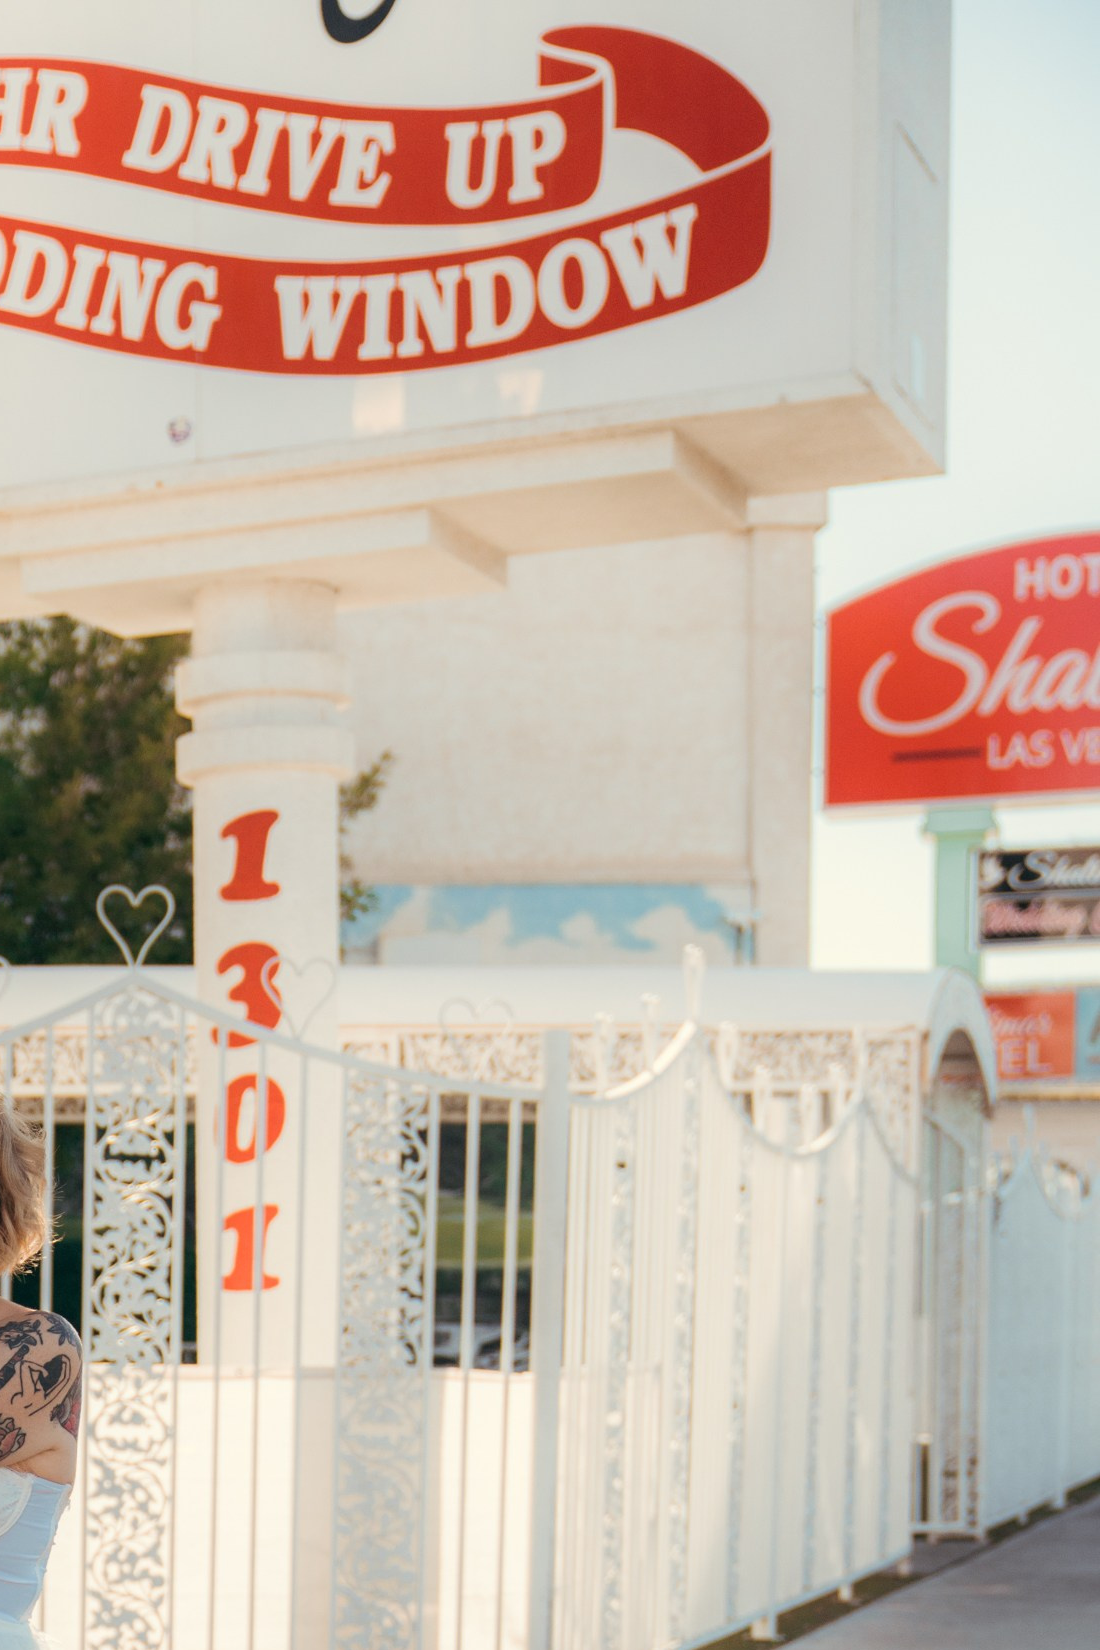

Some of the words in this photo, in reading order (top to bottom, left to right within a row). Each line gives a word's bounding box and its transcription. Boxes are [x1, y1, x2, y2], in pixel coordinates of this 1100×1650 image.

[121, 83, 396, 209] DRIVE
[444, 109, 567, 210] UP
[273, 203, 698, 362] WINDOW
[986, 729, 1054, 770] LAS
